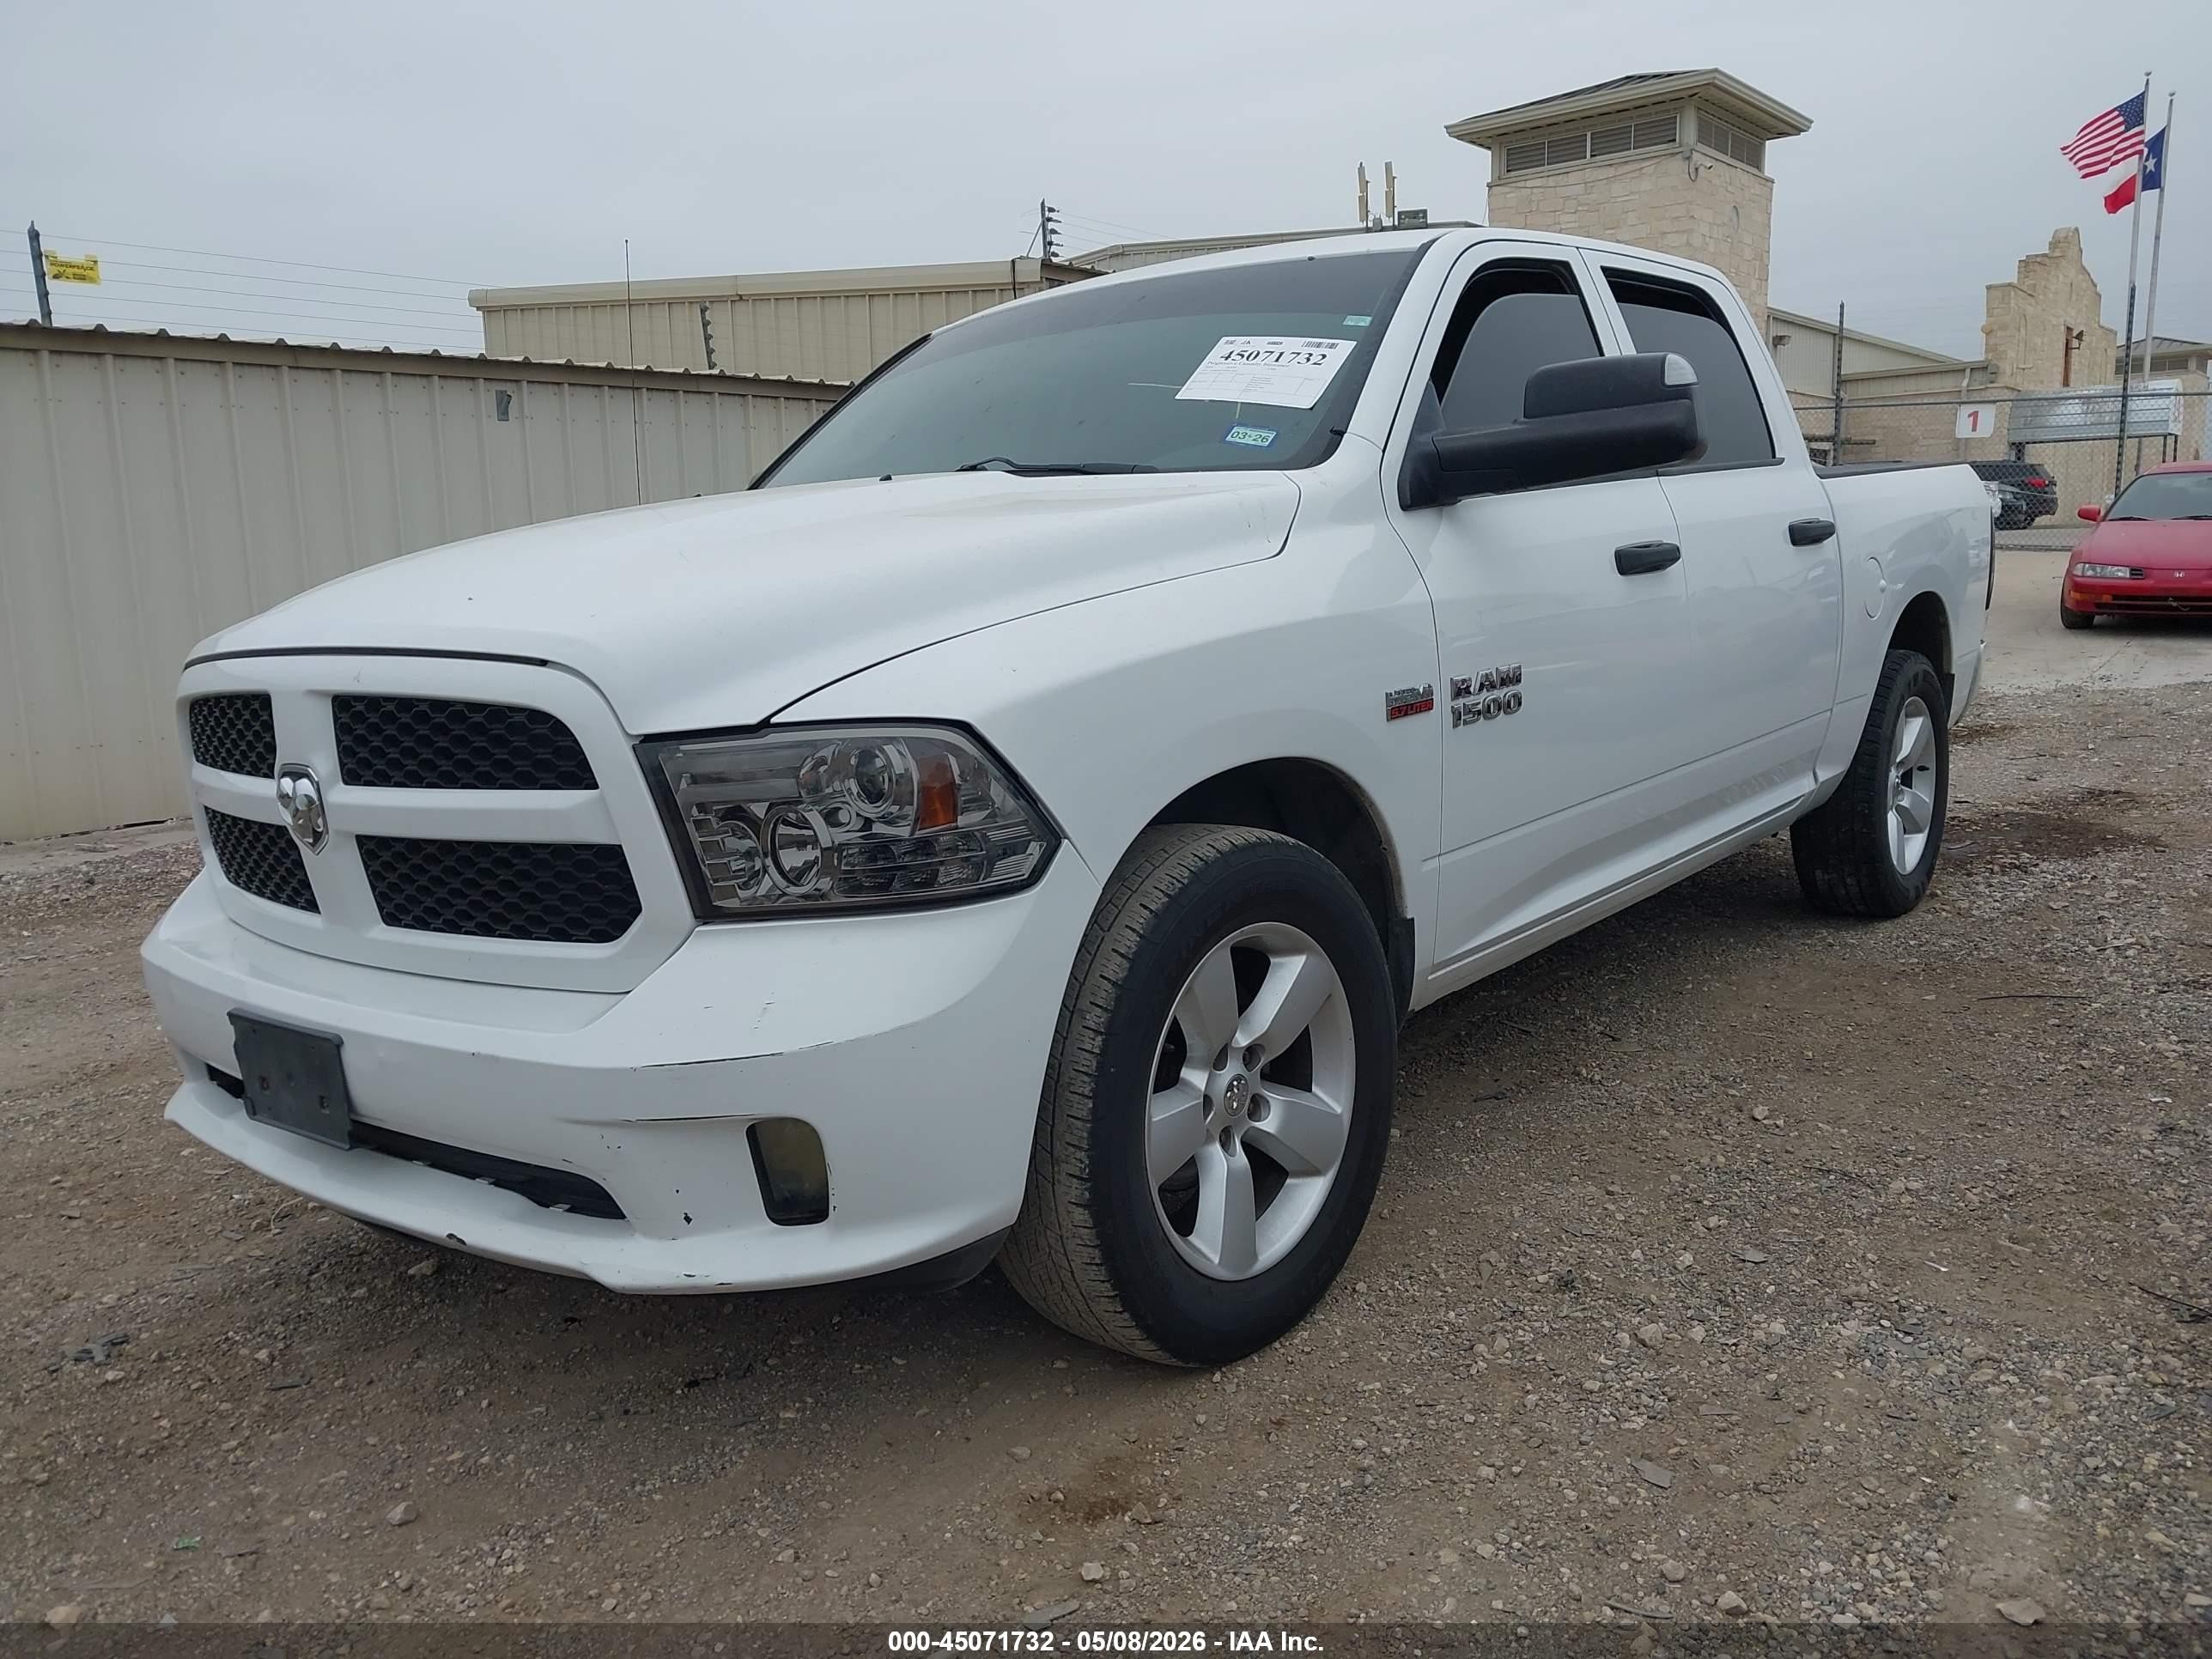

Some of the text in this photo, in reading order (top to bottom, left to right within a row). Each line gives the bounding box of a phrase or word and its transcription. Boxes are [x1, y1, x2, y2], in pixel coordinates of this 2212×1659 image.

[1219, 349, 1328, 366] 45071732
[1967, 410, 1979, 433] 1
[1231, 431, 1271, 443] 03 26
[1449, 663, 1522, 702] RAM
[1450, 690, 1523, 729] 1500
